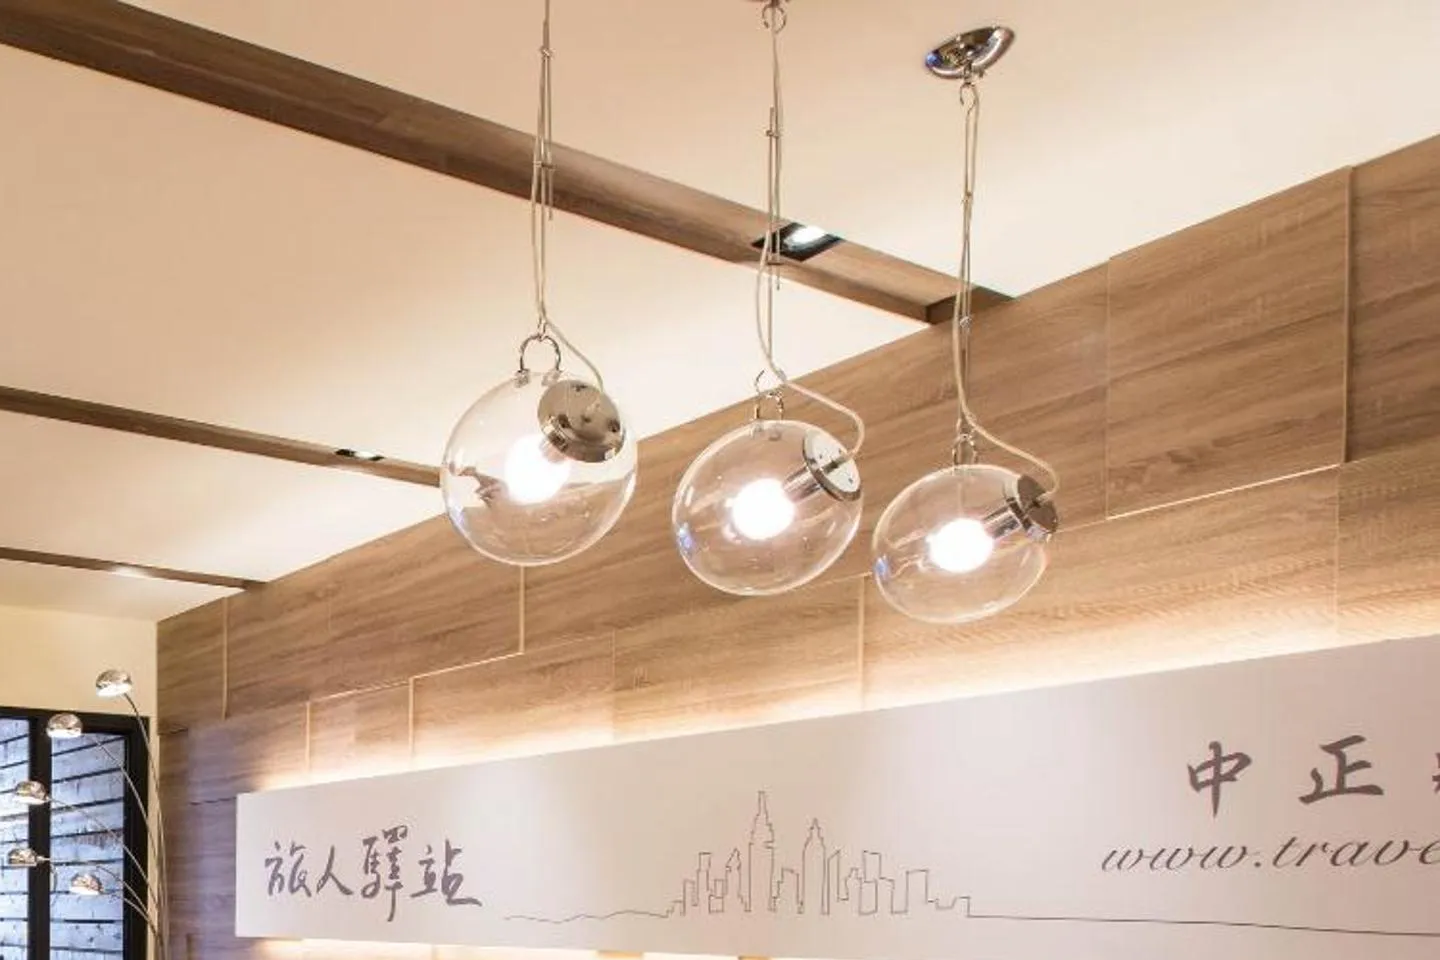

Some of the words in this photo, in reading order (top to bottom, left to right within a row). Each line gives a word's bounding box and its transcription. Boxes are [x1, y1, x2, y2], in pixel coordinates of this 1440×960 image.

[1187, 735, 1440, 818] 中正
[264, 824, 482, 922] 旅人驛站
